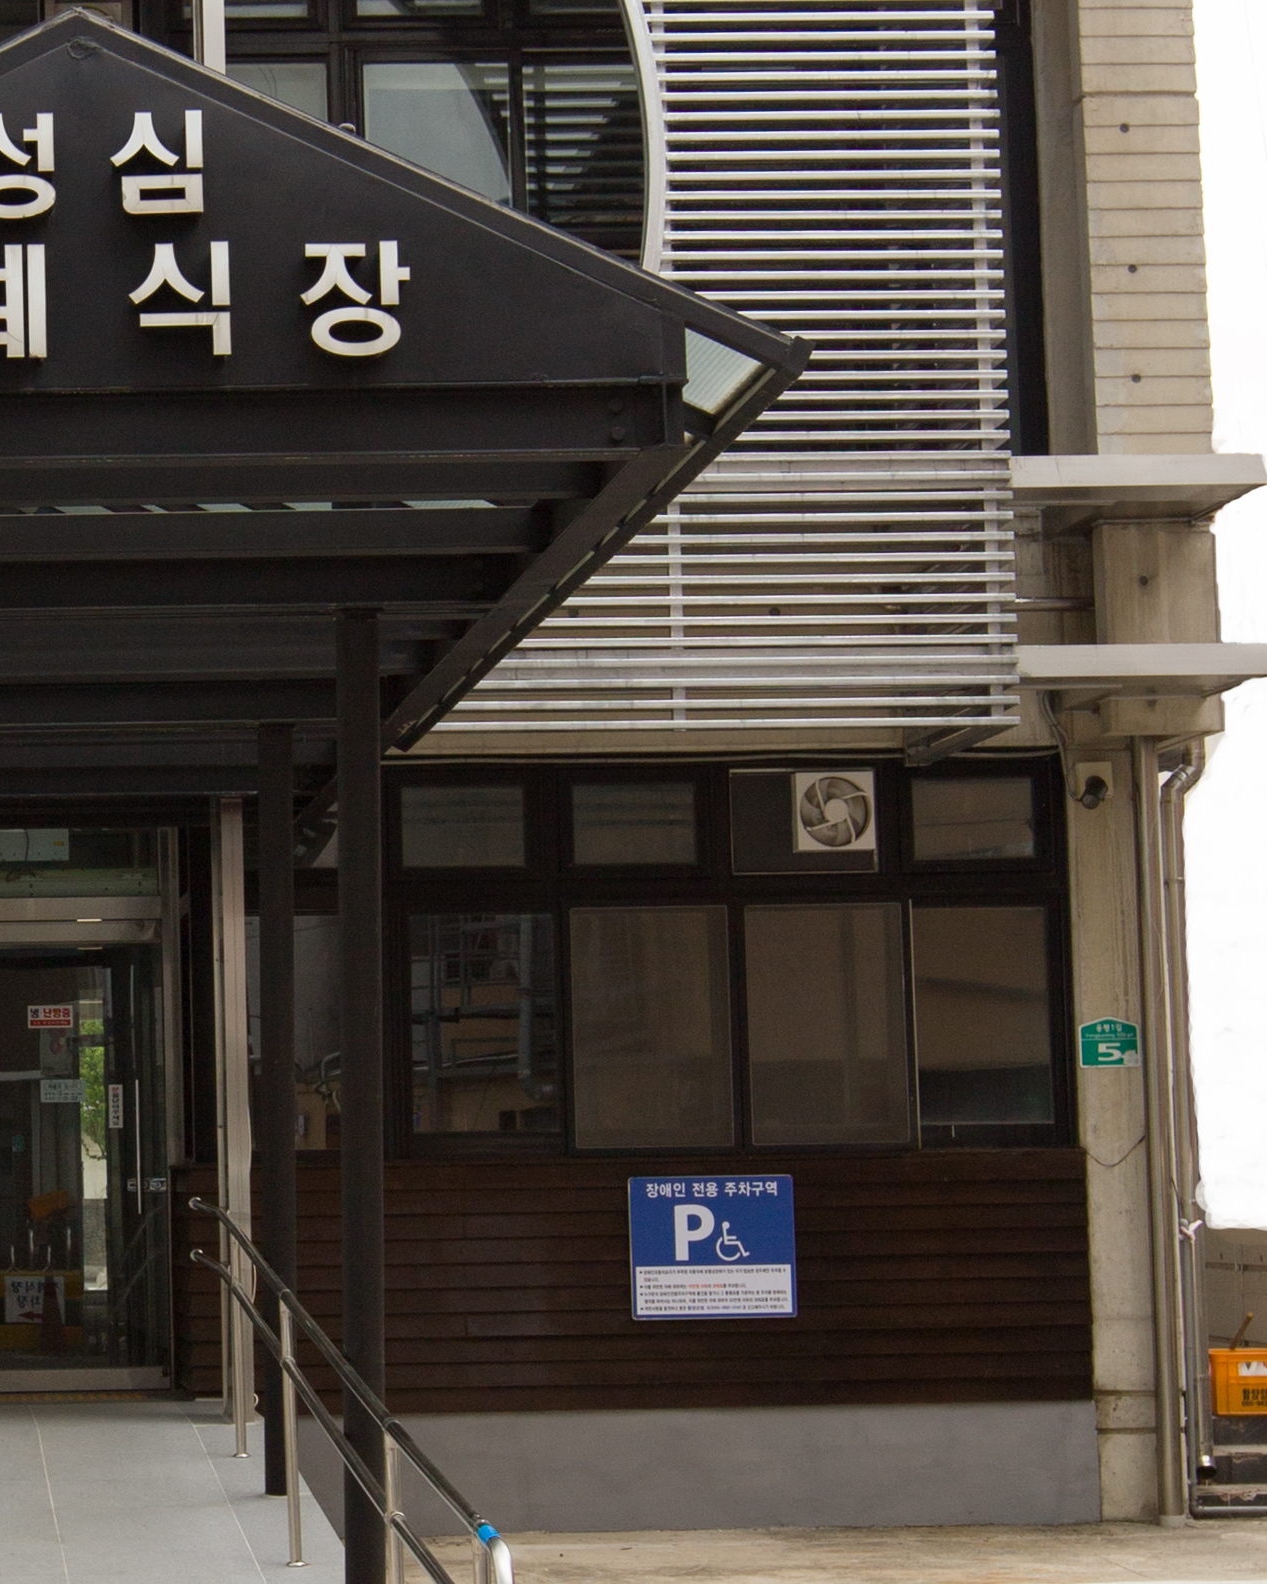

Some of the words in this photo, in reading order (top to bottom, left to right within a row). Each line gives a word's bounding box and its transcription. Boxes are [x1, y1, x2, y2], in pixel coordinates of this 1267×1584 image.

[1098, 1043, 1122, 1061] 5
[645, 1182, 686, 1199] 장애인
[692, 1182, 718, 1198] 전용
[724, 1181, 778, 1197] 주차구역
[673, 1203, 715, 1262] P
